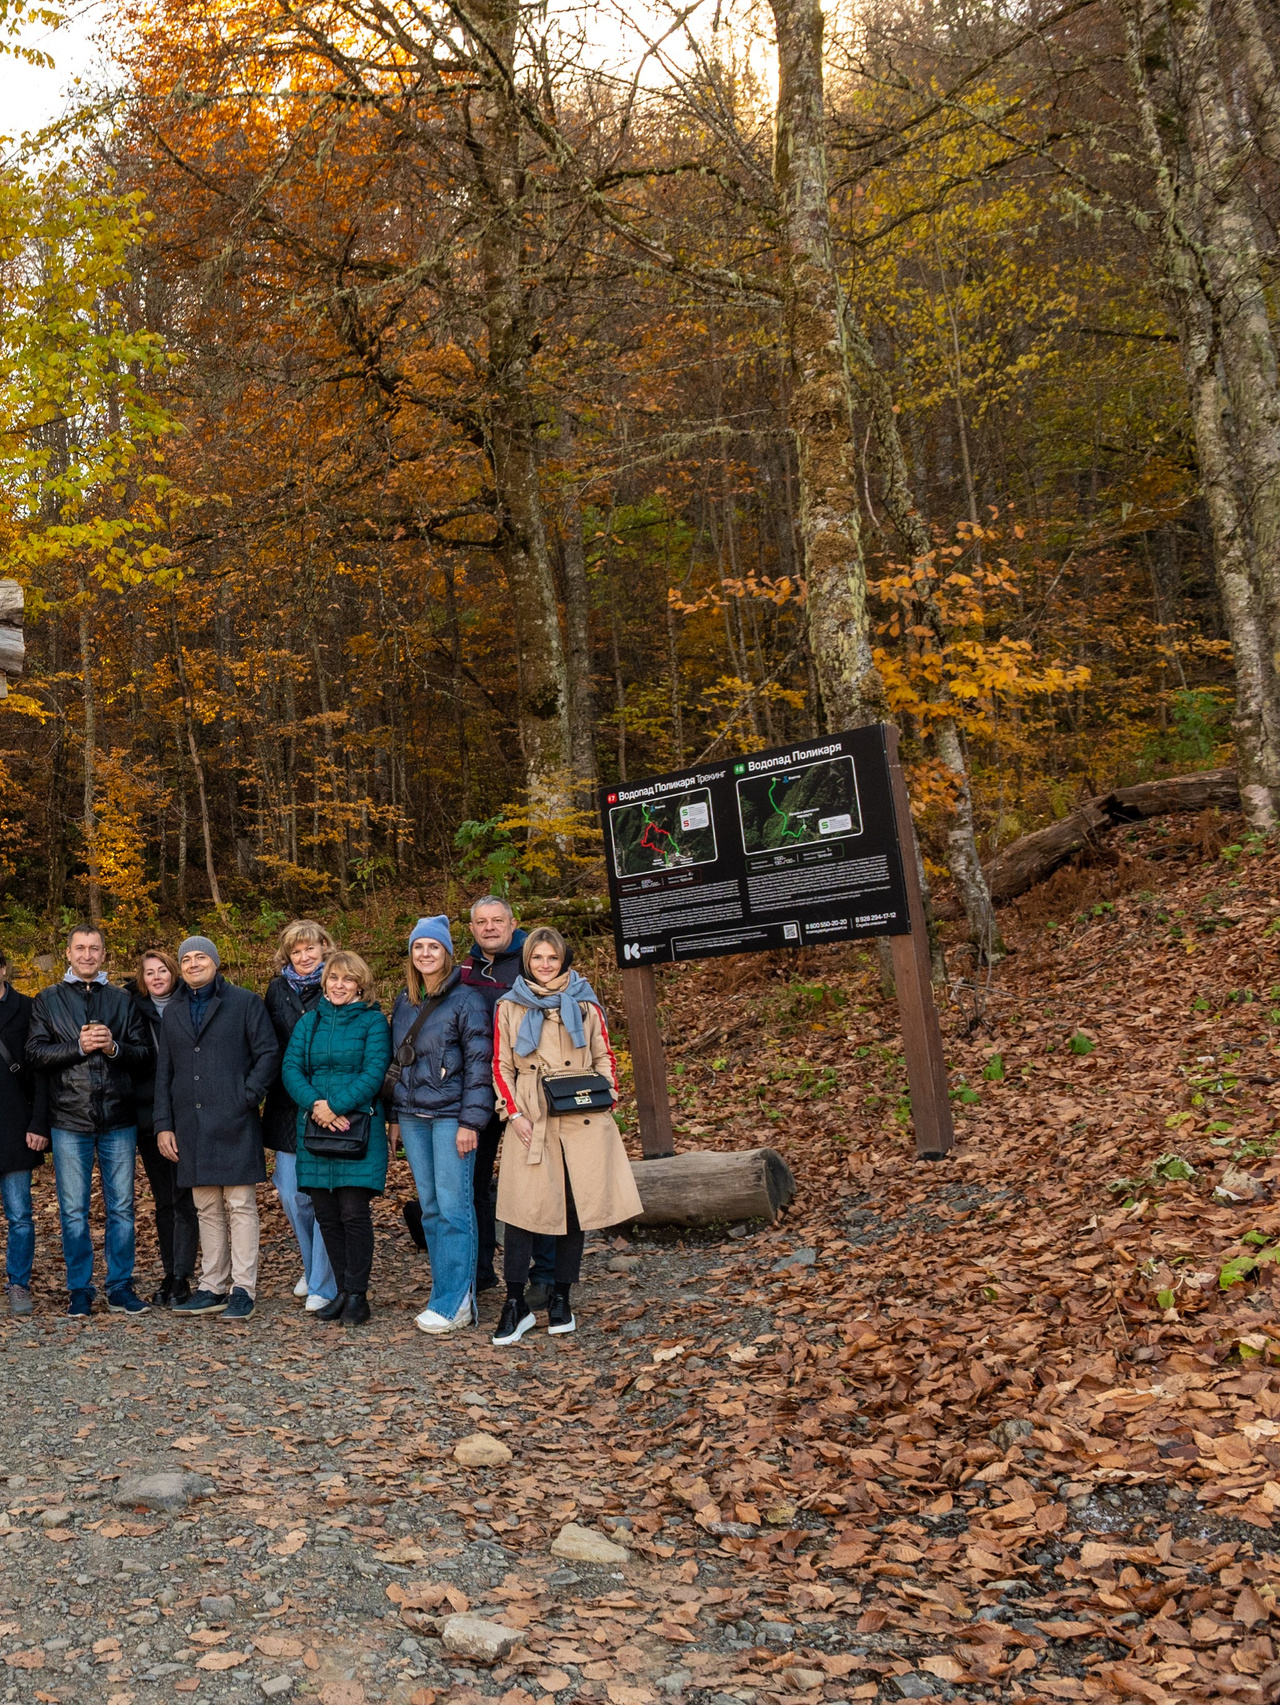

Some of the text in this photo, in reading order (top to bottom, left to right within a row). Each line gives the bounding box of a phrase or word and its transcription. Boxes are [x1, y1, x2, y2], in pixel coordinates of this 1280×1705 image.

[747, 755, 792, 772] Водопад
[793, 743, 842, 762] Поликаря
[618, 788, 654, 801] Водопад
[655, 777, 696, 793] Поликаря
[696, 771, 727, 784] Трекинг
